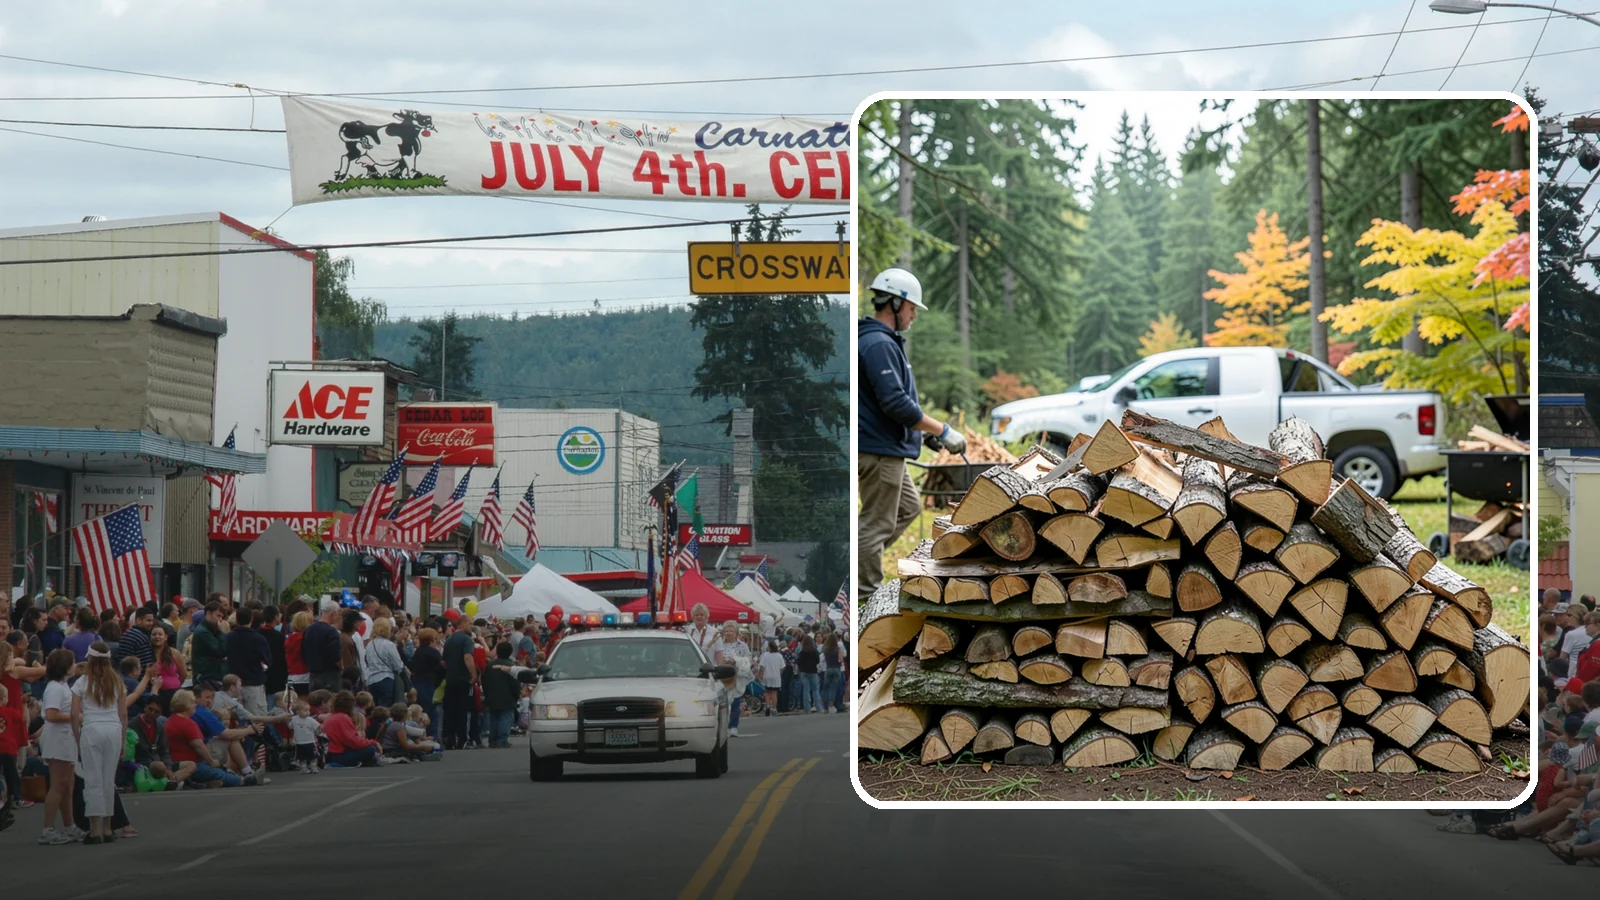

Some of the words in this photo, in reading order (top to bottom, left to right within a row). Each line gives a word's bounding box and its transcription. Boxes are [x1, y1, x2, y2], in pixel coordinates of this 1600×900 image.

[481, 140, 605, 193] JULY
[632, 150, 746, 198] 4th.
[697, 254, 850, 280] CROSSWA
[283, 380, 373, 420] ACE
[405, 409, 452, 421] CEDAR
[461, 409, 485, 421] LOG
[283, 421, 371, 437] Hardware
[354, 467, 385, 479] Simpl
[96, 485, 124, 495] Vincent
[126, 486, 136, 495] de
[137, 486, 155, 495] Paul
[687, 526, 742, 535] CRNATION
[699, 535, 730, 543] GLASS
